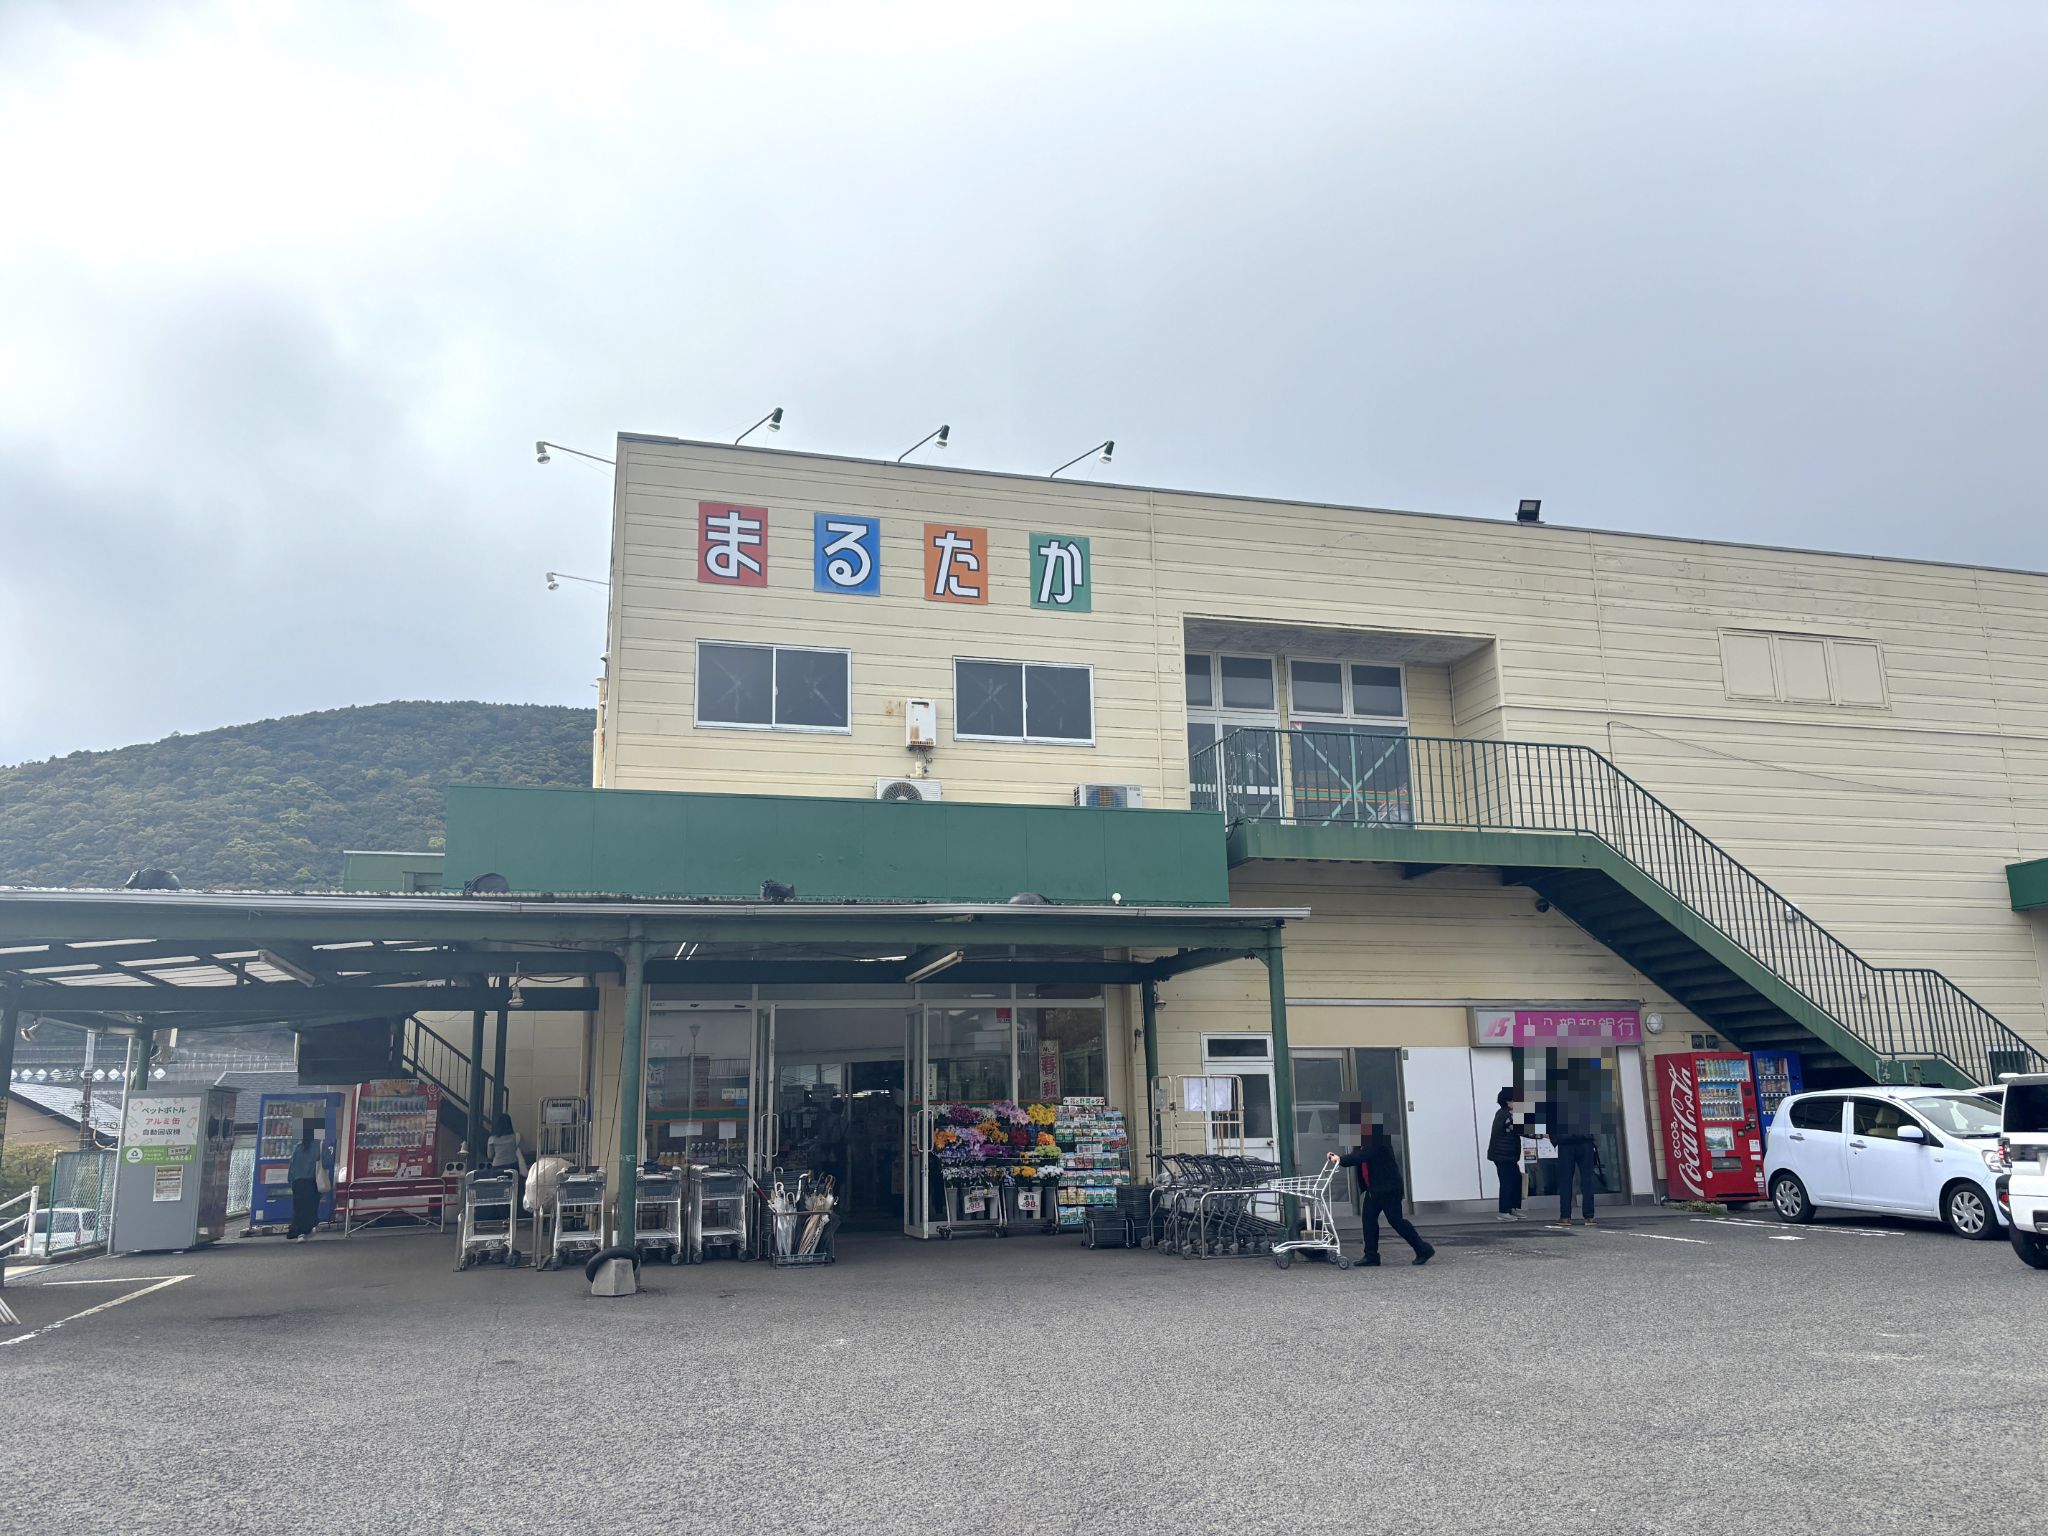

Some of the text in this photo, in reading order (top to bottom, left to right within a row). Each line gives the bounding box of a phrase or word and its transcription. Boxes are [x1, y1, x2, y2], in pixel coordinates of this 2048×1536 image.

[705, 509, 1084, 604] まるたか
[142, 1106, 187, 1114] ペットボトル
[146, 1117, 181, 1125] アルミ缶
[1666, 1058, 1704, 1197] Coca-Cola
